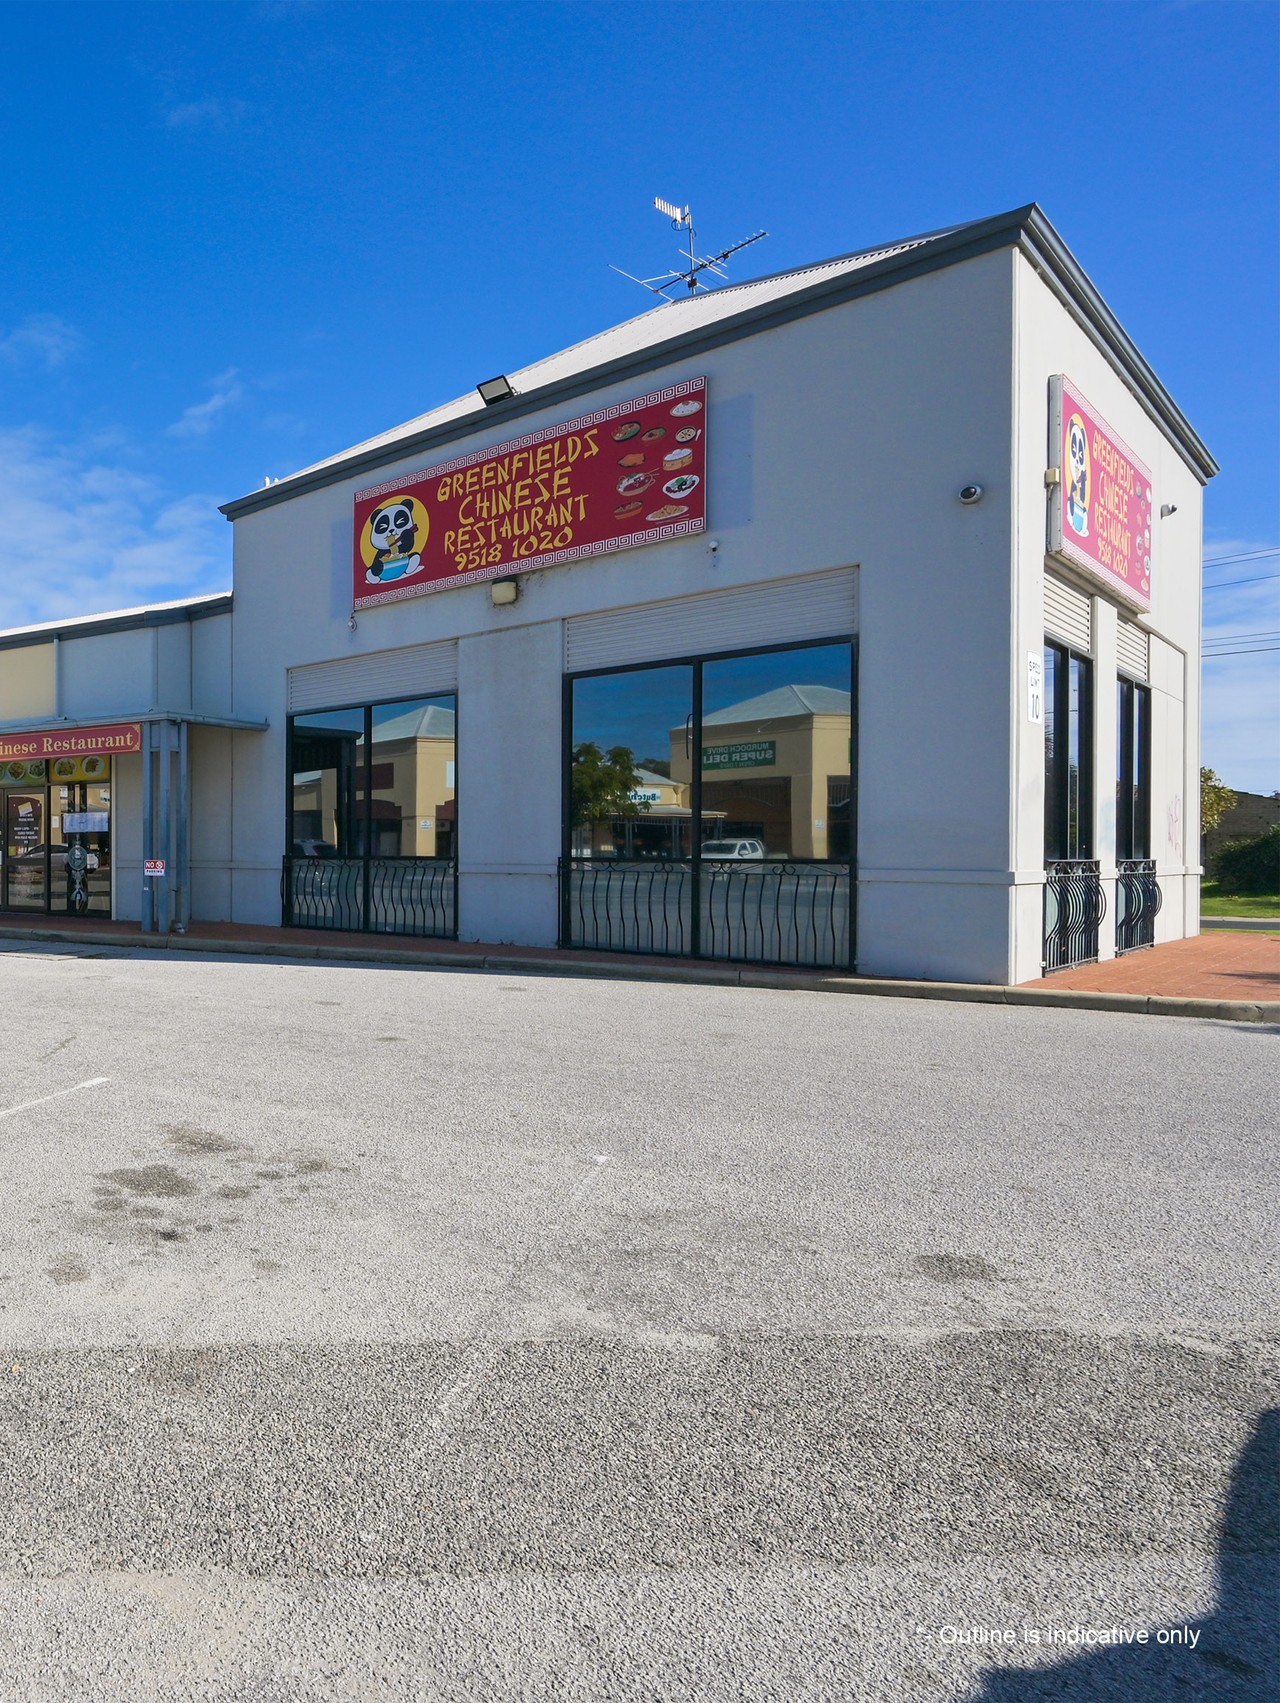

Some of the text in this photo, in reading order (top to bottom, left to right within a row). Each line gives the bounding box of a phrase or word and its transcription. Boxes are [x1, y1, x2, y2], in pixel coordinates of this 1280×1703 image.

[436, 428, 600, 502] GREENFIELDS
[1092, 430, 1135, 497] GREENFIELDS
[444, 494, 589, 554] RESTAURANT
[459, 466, 572, 525] CHINESE
[1099, 471, 1129, 524] CHINESE
[455, 526, 573, 572] 9518 1020
[1094, 502, 1131, 559] RESTAURANT
[1032, 693, 1040, 720] 10
[42, 731, 134, 752] Restaurant
